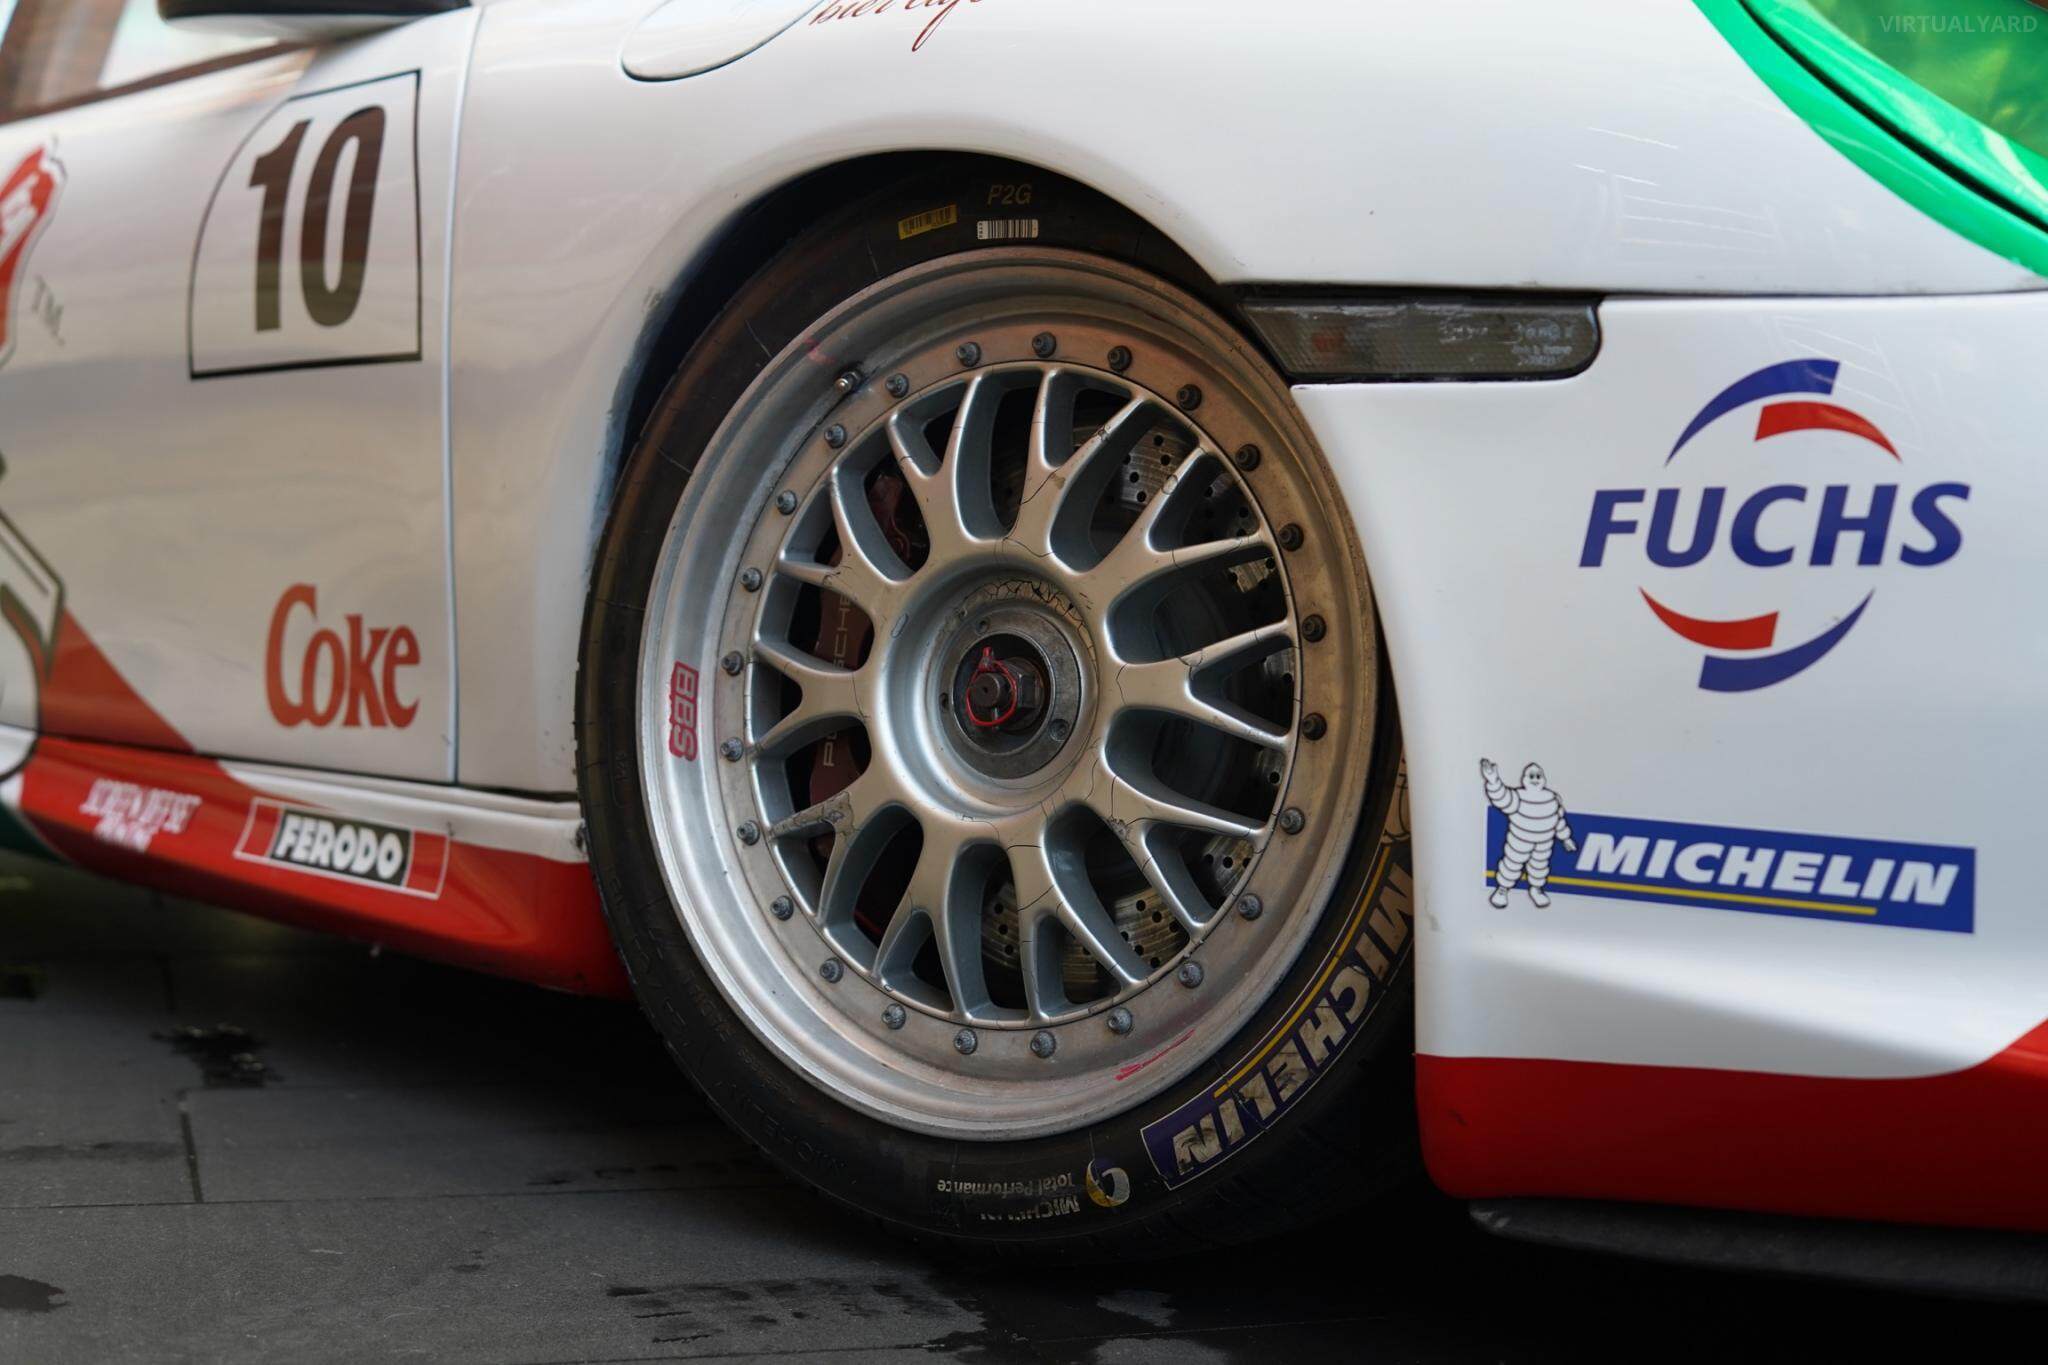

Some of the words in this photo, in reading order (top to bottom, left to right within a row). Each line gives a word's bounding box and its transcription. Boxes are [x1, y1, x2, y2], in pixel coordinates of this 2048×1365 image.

[248, 105, 386, 332] 10
[986, 183, 1032, 205] P2G
[1578, 481, 1971, 568] FUCHS
[265, 582, 421, 729] Coke
[670, 664, 698, 760] BBS
[273, 814, 405, 881] FERODO
[1575, 831, 1960, 906] MICHELIN
[1172, 862, 1414, 1176] MICHELIN
[936, 1179, 1034, 1199] Performance
[1037, 1172, 1075, 1193] Total
